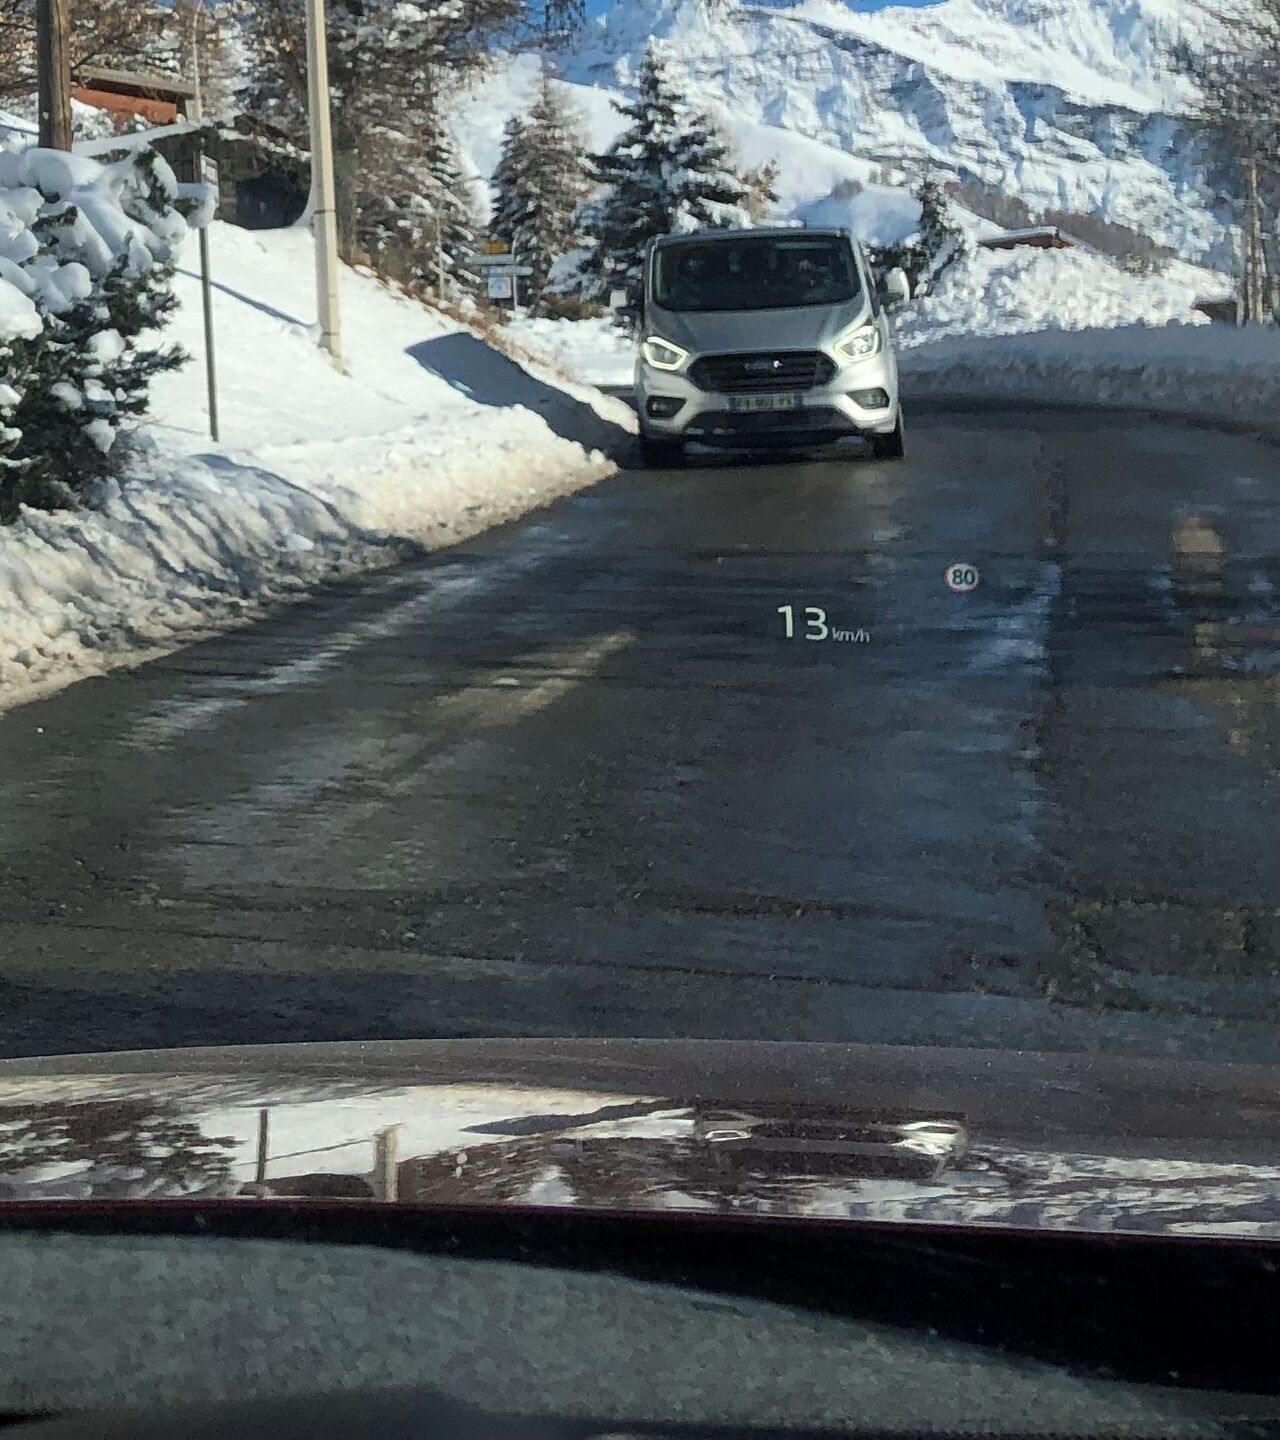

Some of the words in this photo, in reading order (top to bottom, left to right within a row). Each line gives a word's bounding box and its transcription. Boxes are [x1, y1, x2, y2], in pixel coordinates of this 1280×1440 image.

[951, 568, 976, 586] 80
[777, 604, 829, 641] 13
[832, 627, 870, 644] km/h
